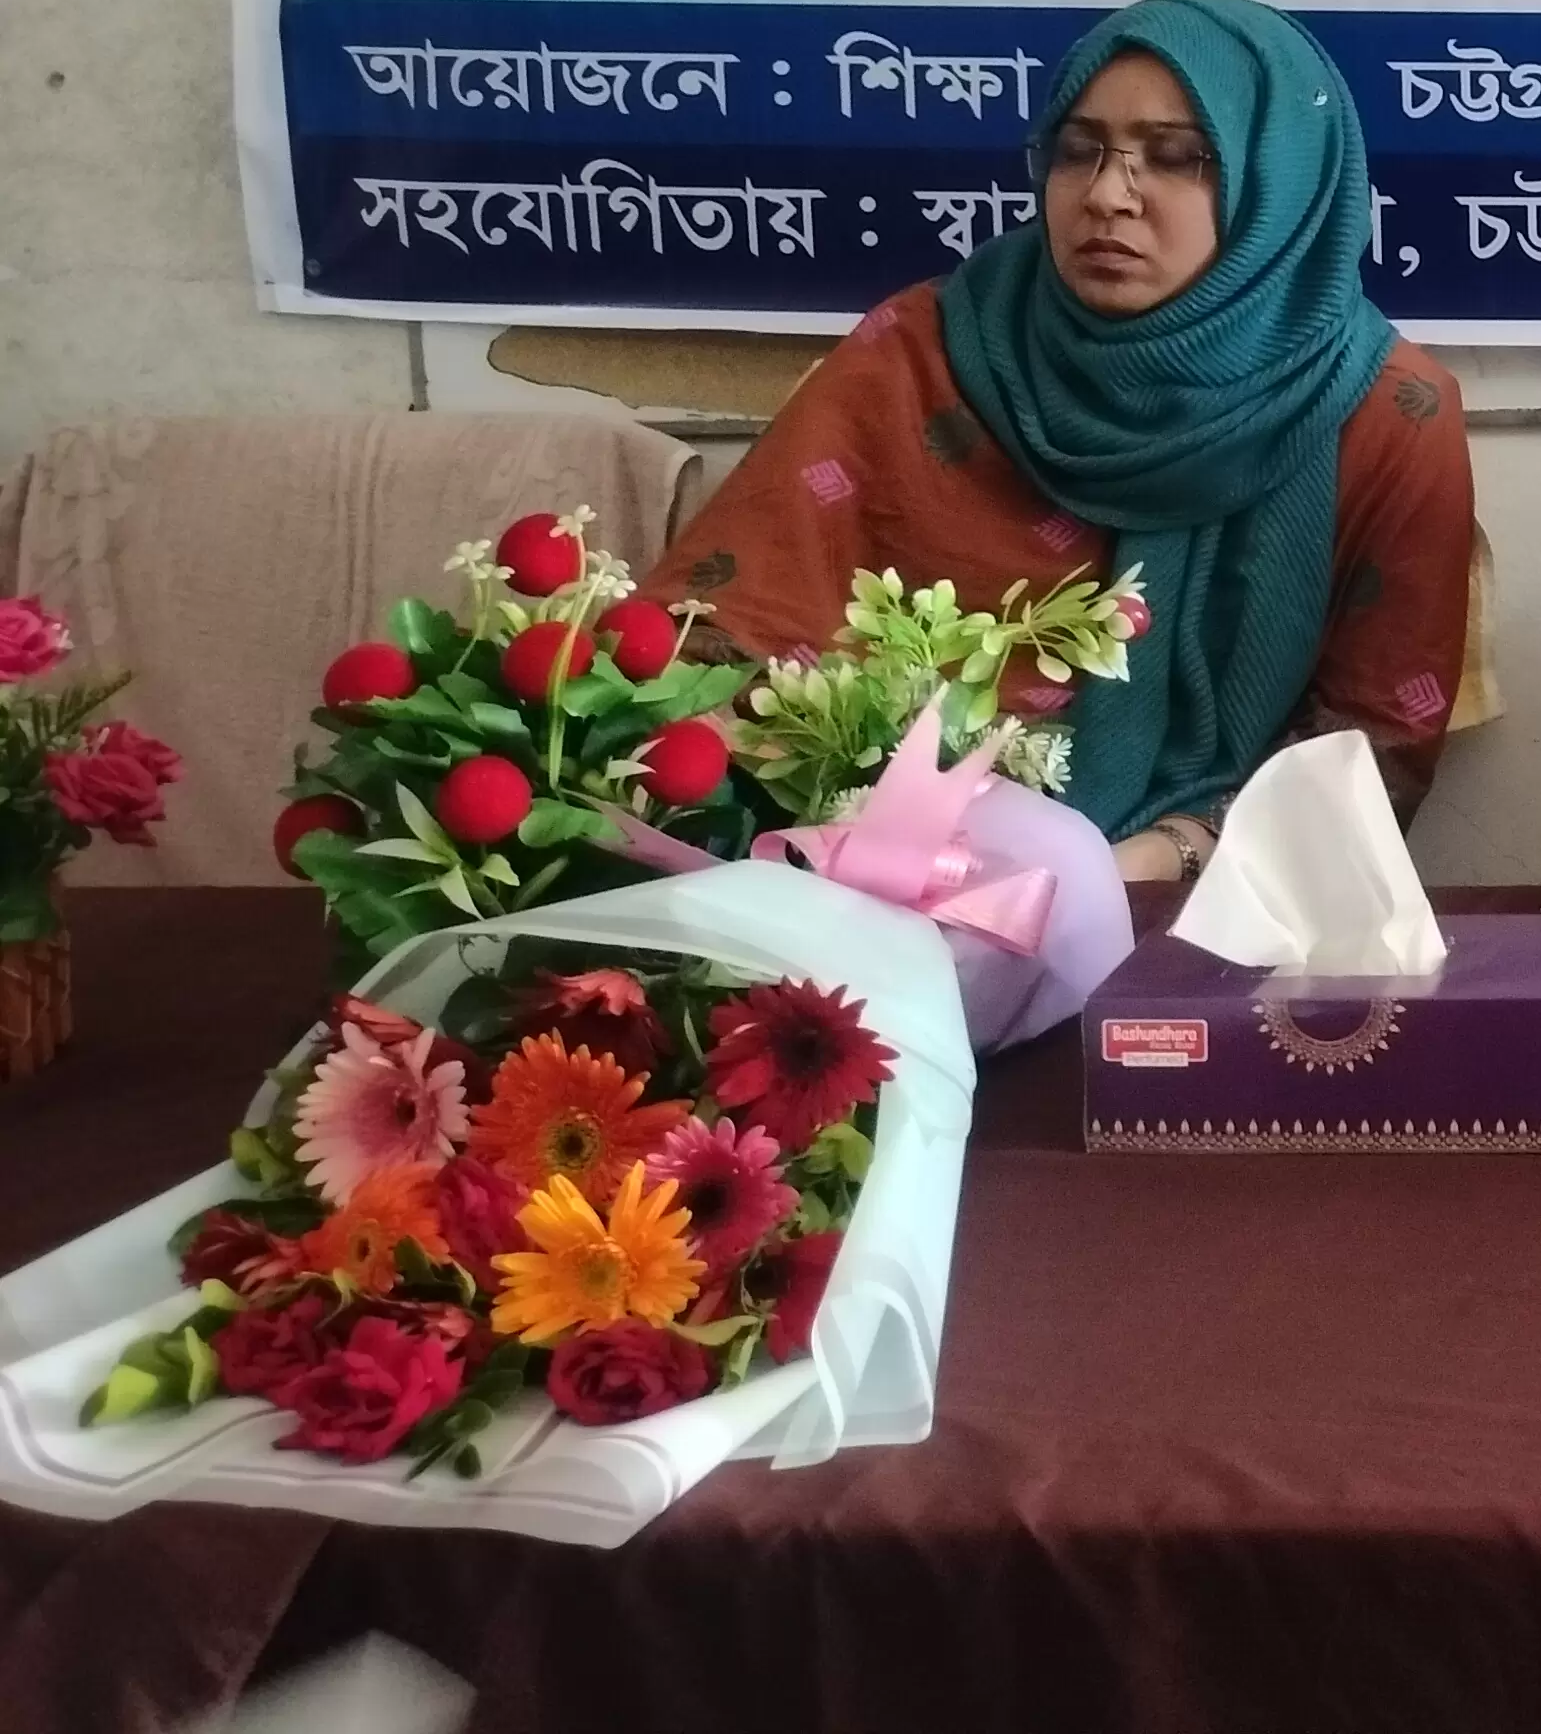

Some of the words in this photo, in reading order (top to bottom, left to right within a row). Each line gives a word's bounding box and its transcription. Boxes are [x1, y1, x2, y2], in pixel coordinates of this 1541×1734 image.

[343, 39, 740, 115] আয়োজনে
[826, 31, 1043, 120] শিক্ষা
[354, 159, 827, 258] সহযোগিতায়
[1113, 1025, 1198, 1041] Bashundhara
